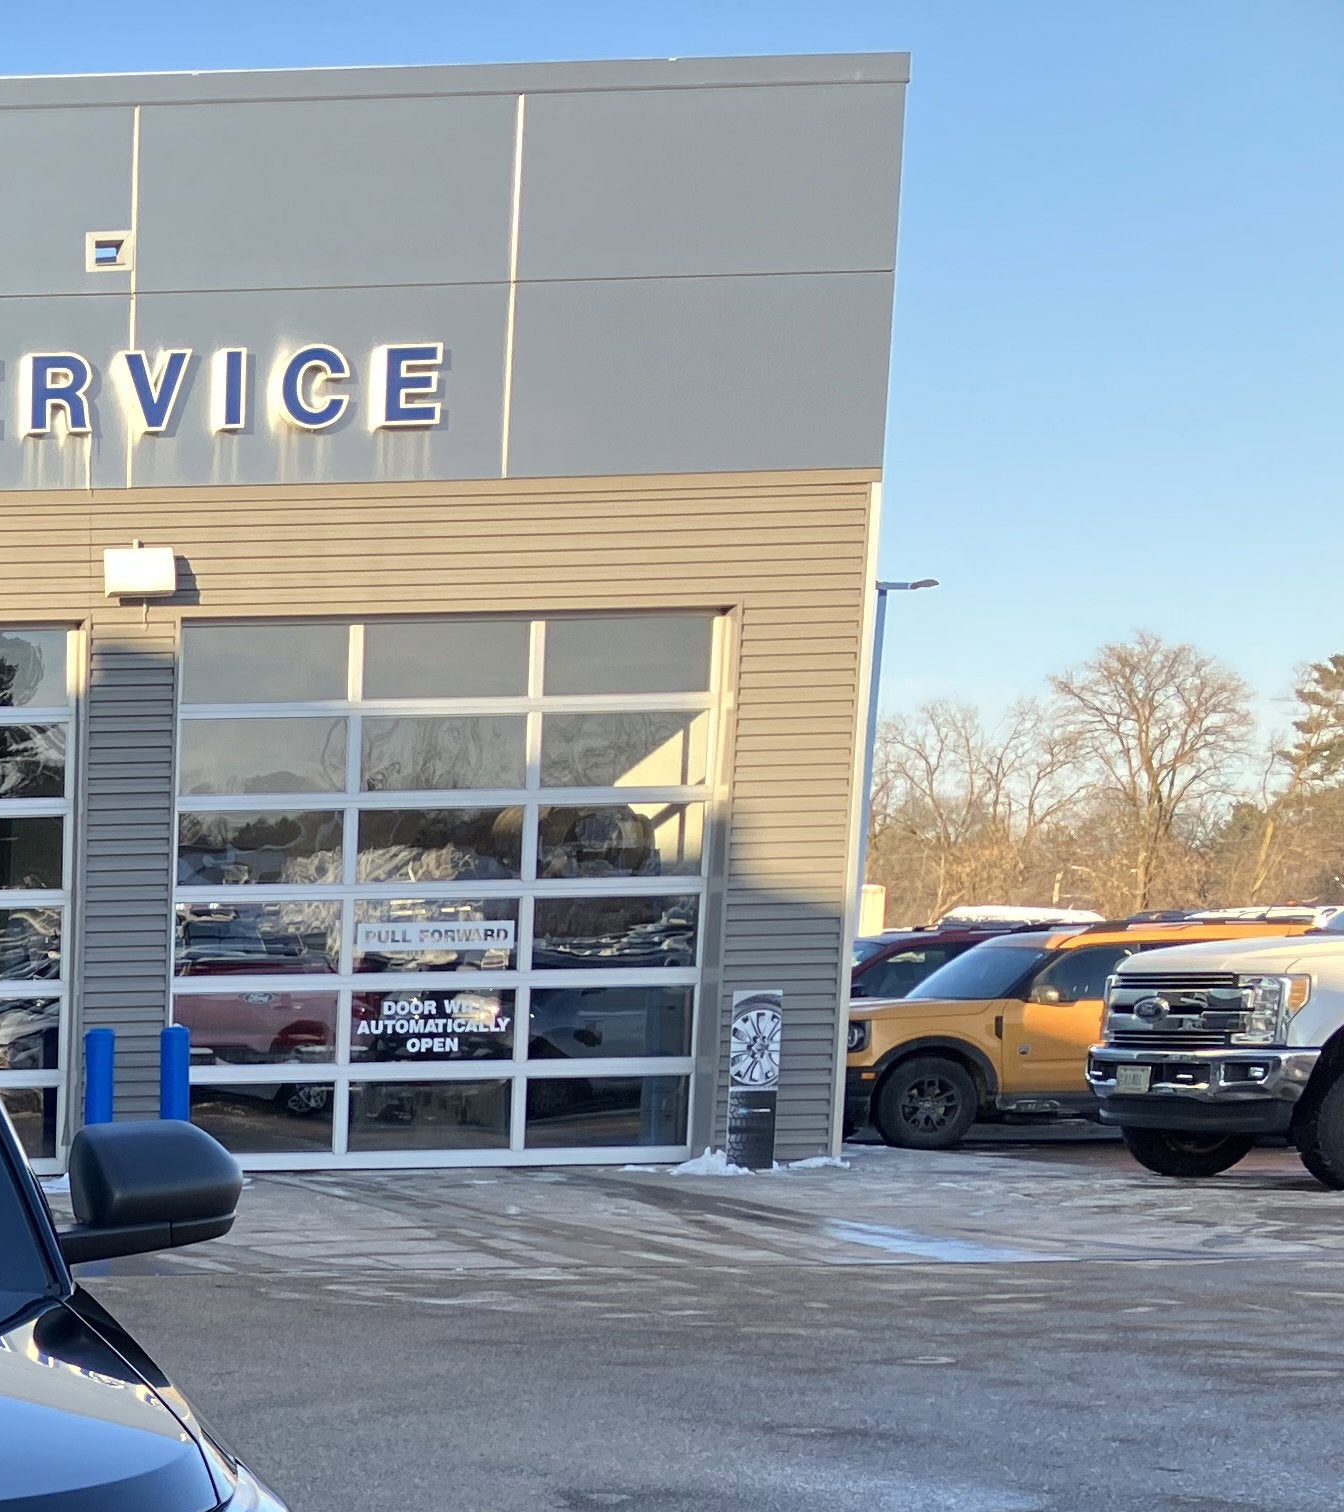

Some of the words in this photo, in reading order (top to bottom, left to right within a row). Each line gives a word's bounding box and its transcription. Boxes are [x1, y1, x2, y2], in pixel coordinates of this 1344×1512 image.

[365, 929, 411, 944] PULL
[419, 928, 509, 943] FORWARD
[383, 1000, 437, 1016] DOOR
[357, 1017, 511, 1034] AUTOMATICALLY
[406, 1037, 459, 1053] OPEN
